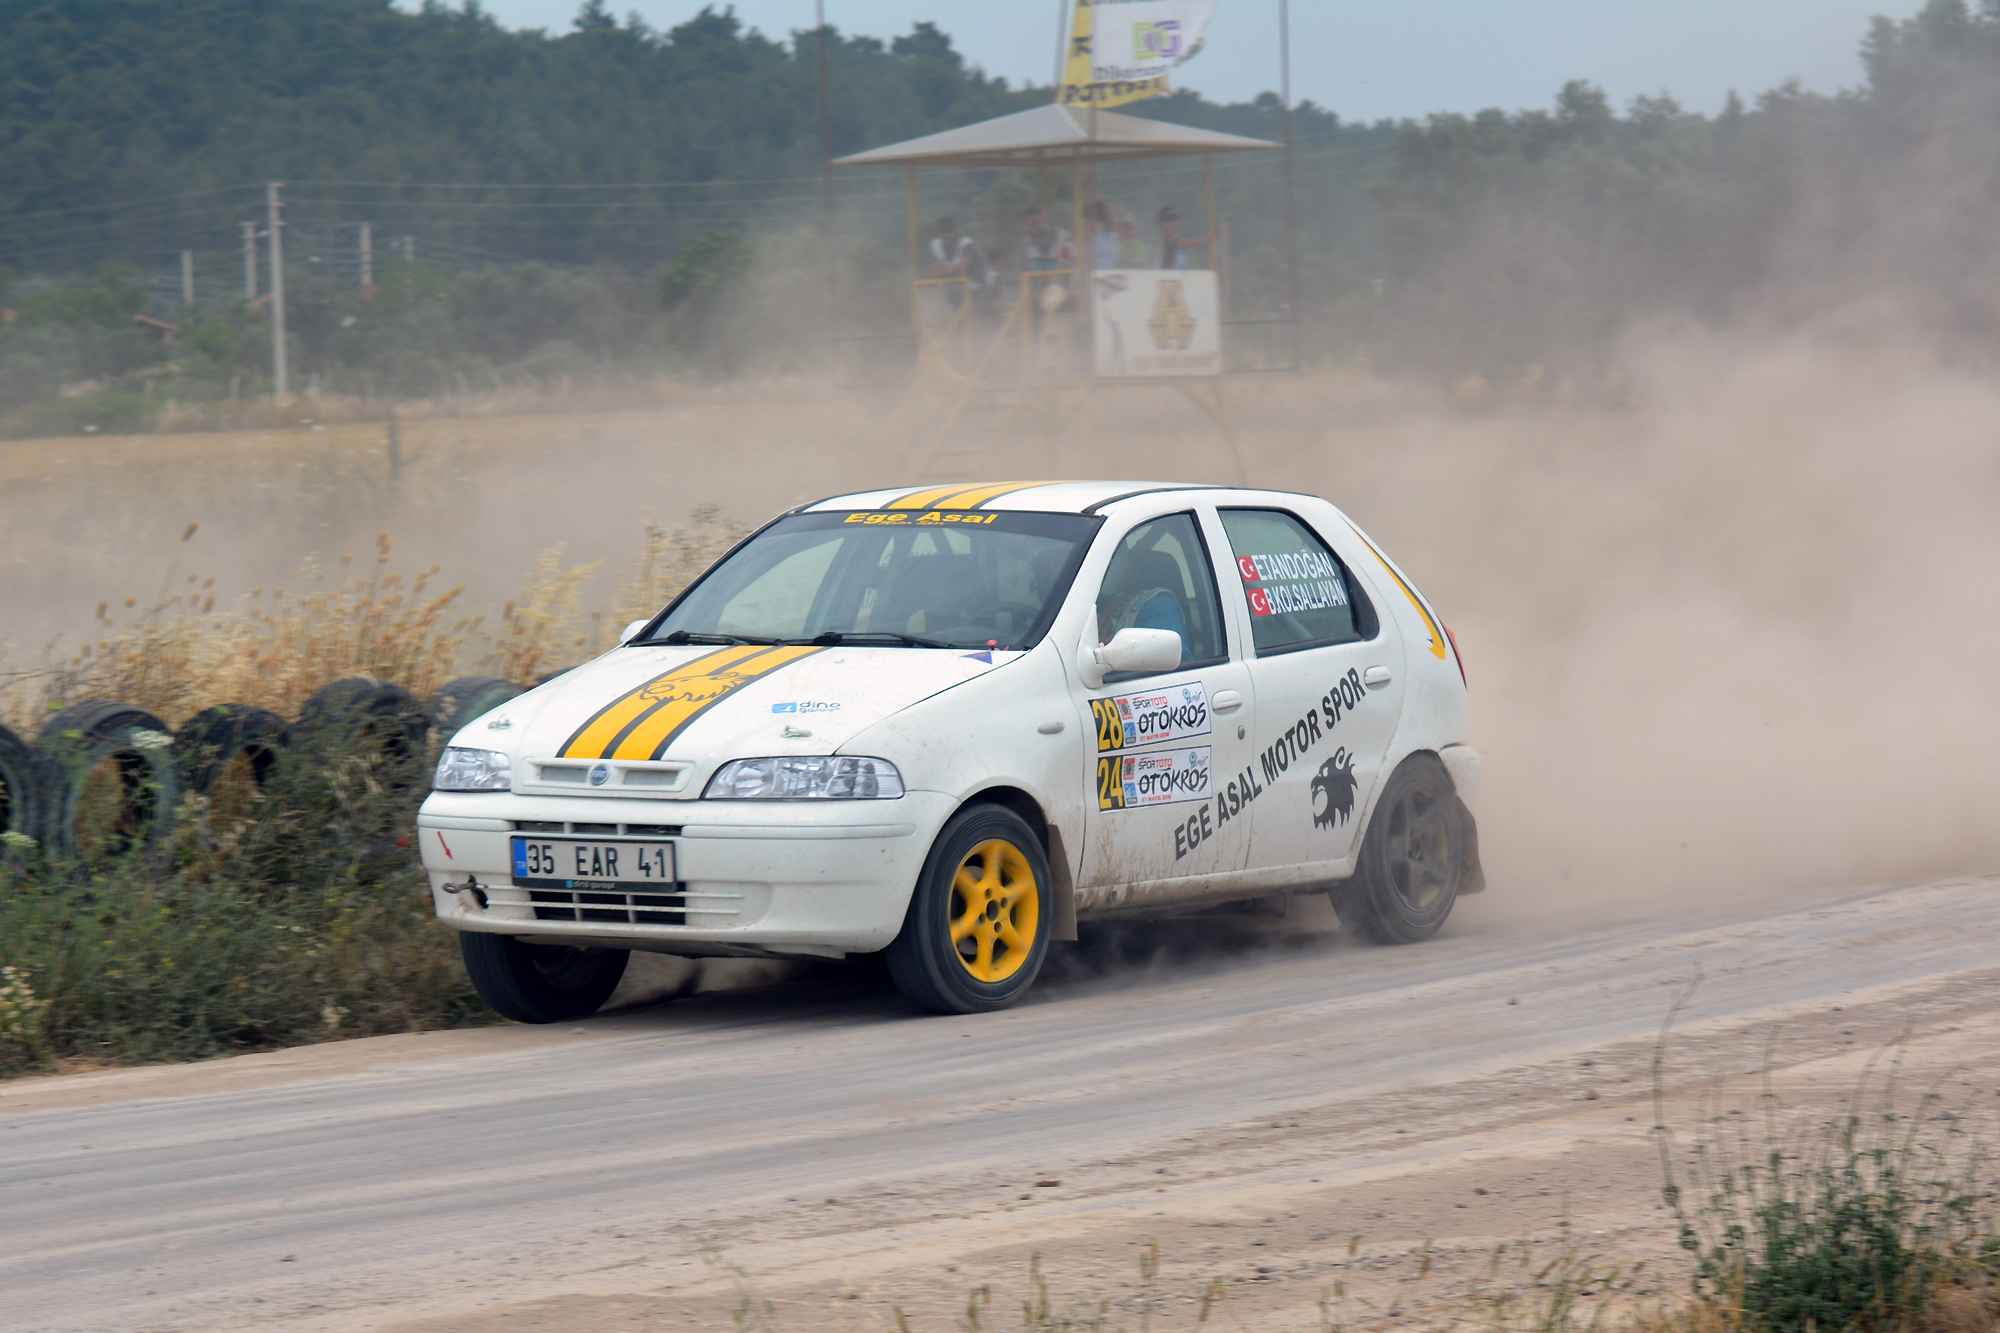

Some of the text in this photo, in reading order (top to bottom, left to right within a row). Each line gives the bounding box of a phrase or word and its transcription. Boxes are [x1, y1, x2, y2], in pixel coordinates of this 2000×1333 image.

[843, 511, 998, 525] Ege Asal
[799, 701, 841, 709] dino
[1138, 702, 1207, 734] OTOKROS
[1091, 698, 1123, 751] 28
[1174, 667, 1366, 861] EGE ASAL MOTOR SPOR
[1097, 757, 1124, 810] 24
[1138, 767, 1208, 795] OTOKROS
[528, 844, 666, 878] 35 EAR 41
